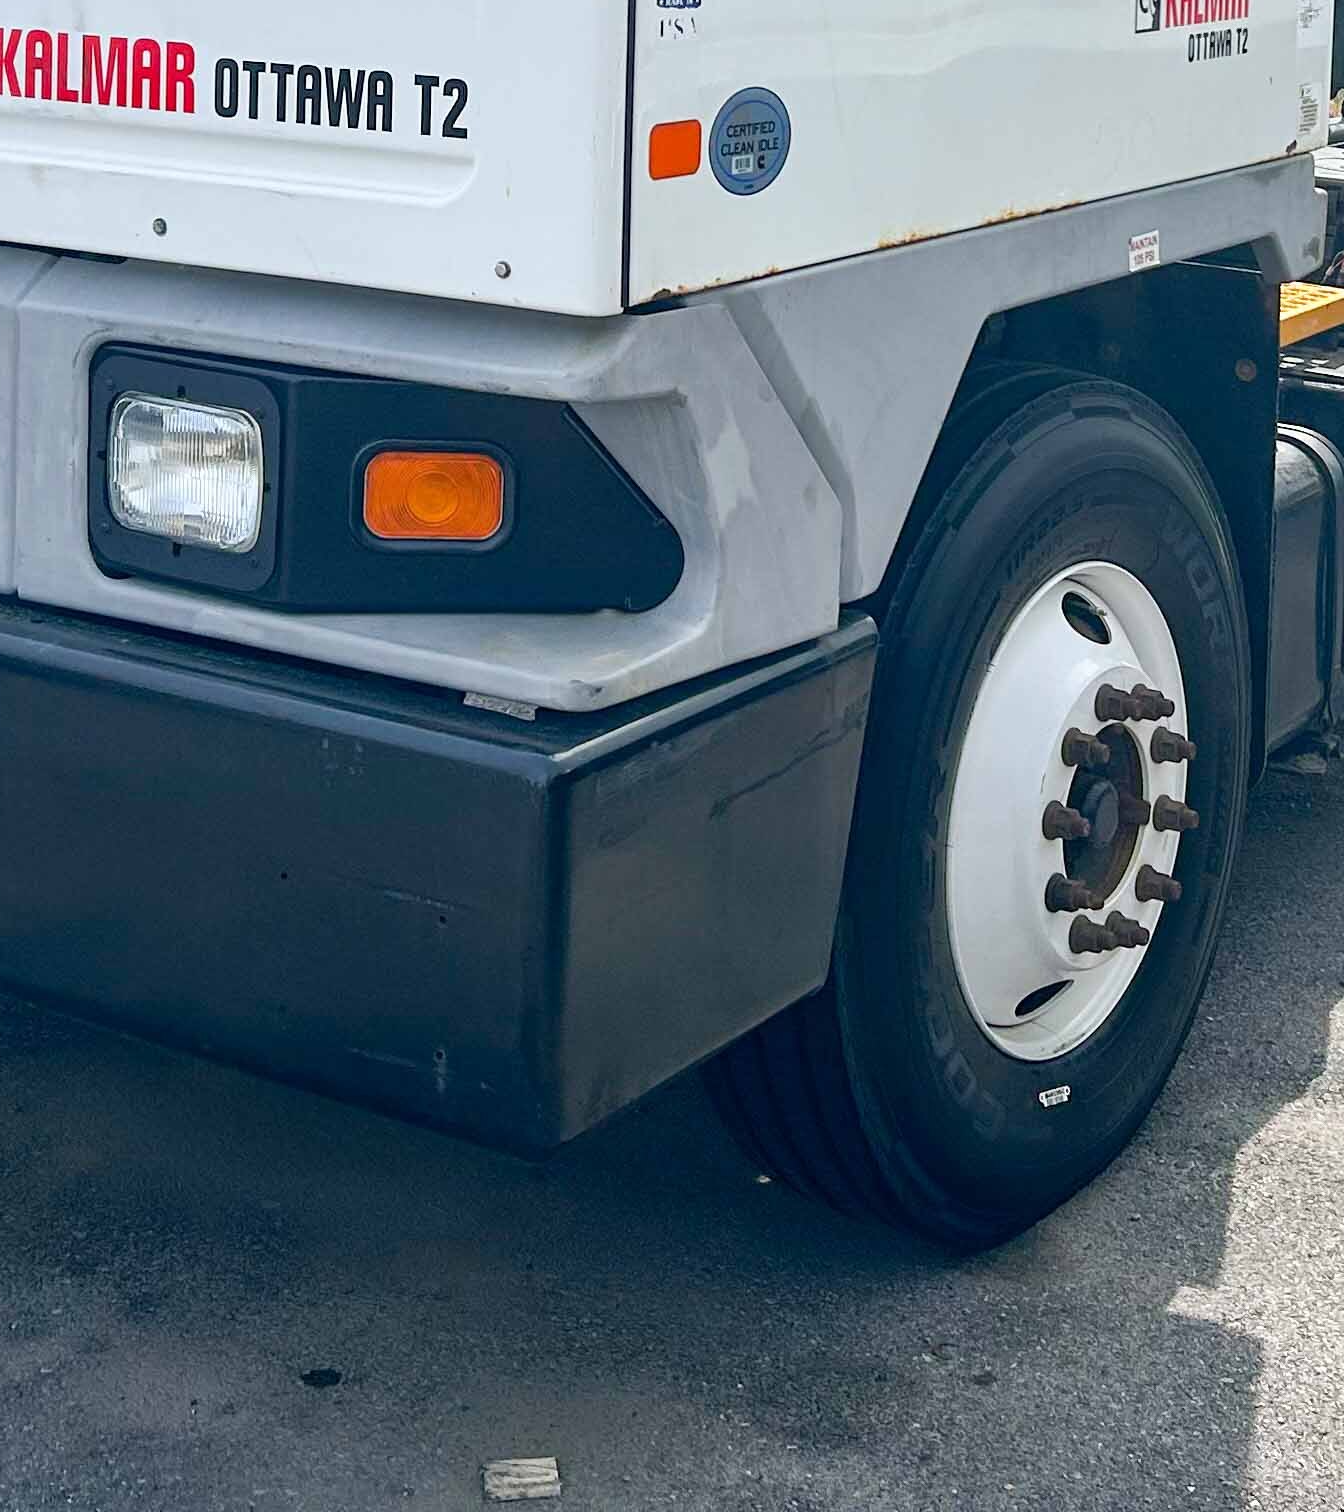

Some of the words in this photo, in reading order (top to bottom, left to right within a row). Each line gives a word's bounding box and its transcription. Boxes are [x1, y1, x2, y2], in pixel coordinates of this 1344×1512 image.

[1188, 29, 1232, 62] OTTAWA
[1236, 28, 1248, 55] T2
[214, 58, 393, 132] OTTAWA
[414, 73, 468, 139] T2
[726, 121, 776, 138] CERTIFIED
[721, 141, 754, 157] CLEAN
[758, 137, 780, 152] IDLE
